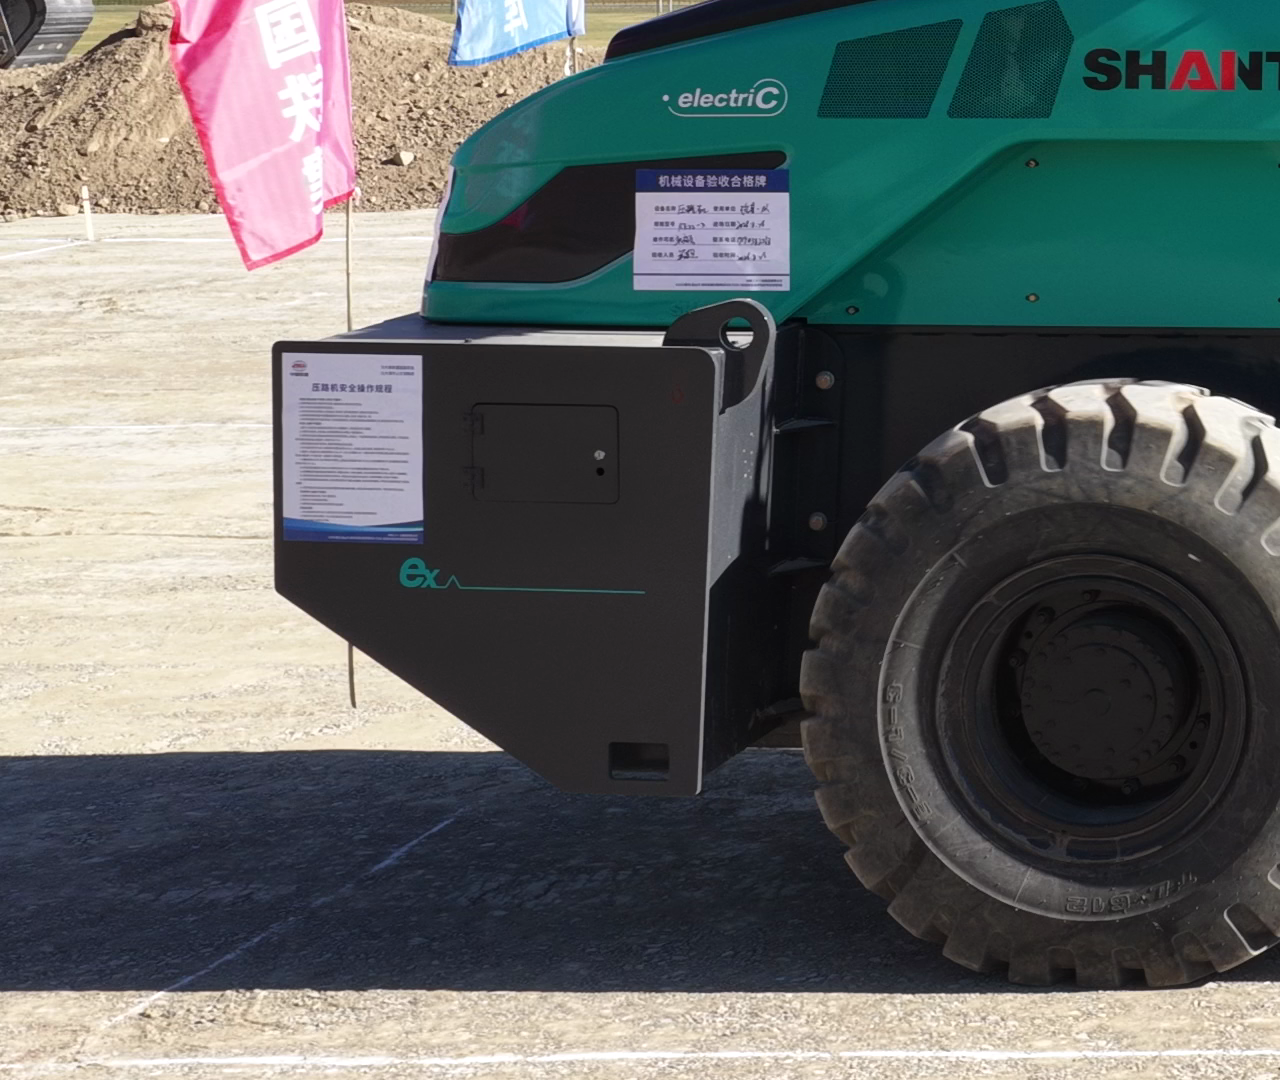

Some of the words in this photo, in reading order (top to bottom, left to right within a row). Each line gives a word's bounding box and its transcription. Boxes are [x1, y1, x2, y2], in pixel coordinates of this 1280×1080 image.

[677, 86, 780, 109] electriC
[658, 175, 767, 188] 机械设备验收合格牌
[312, 383, 392, 393] 压路机安全操作规程
